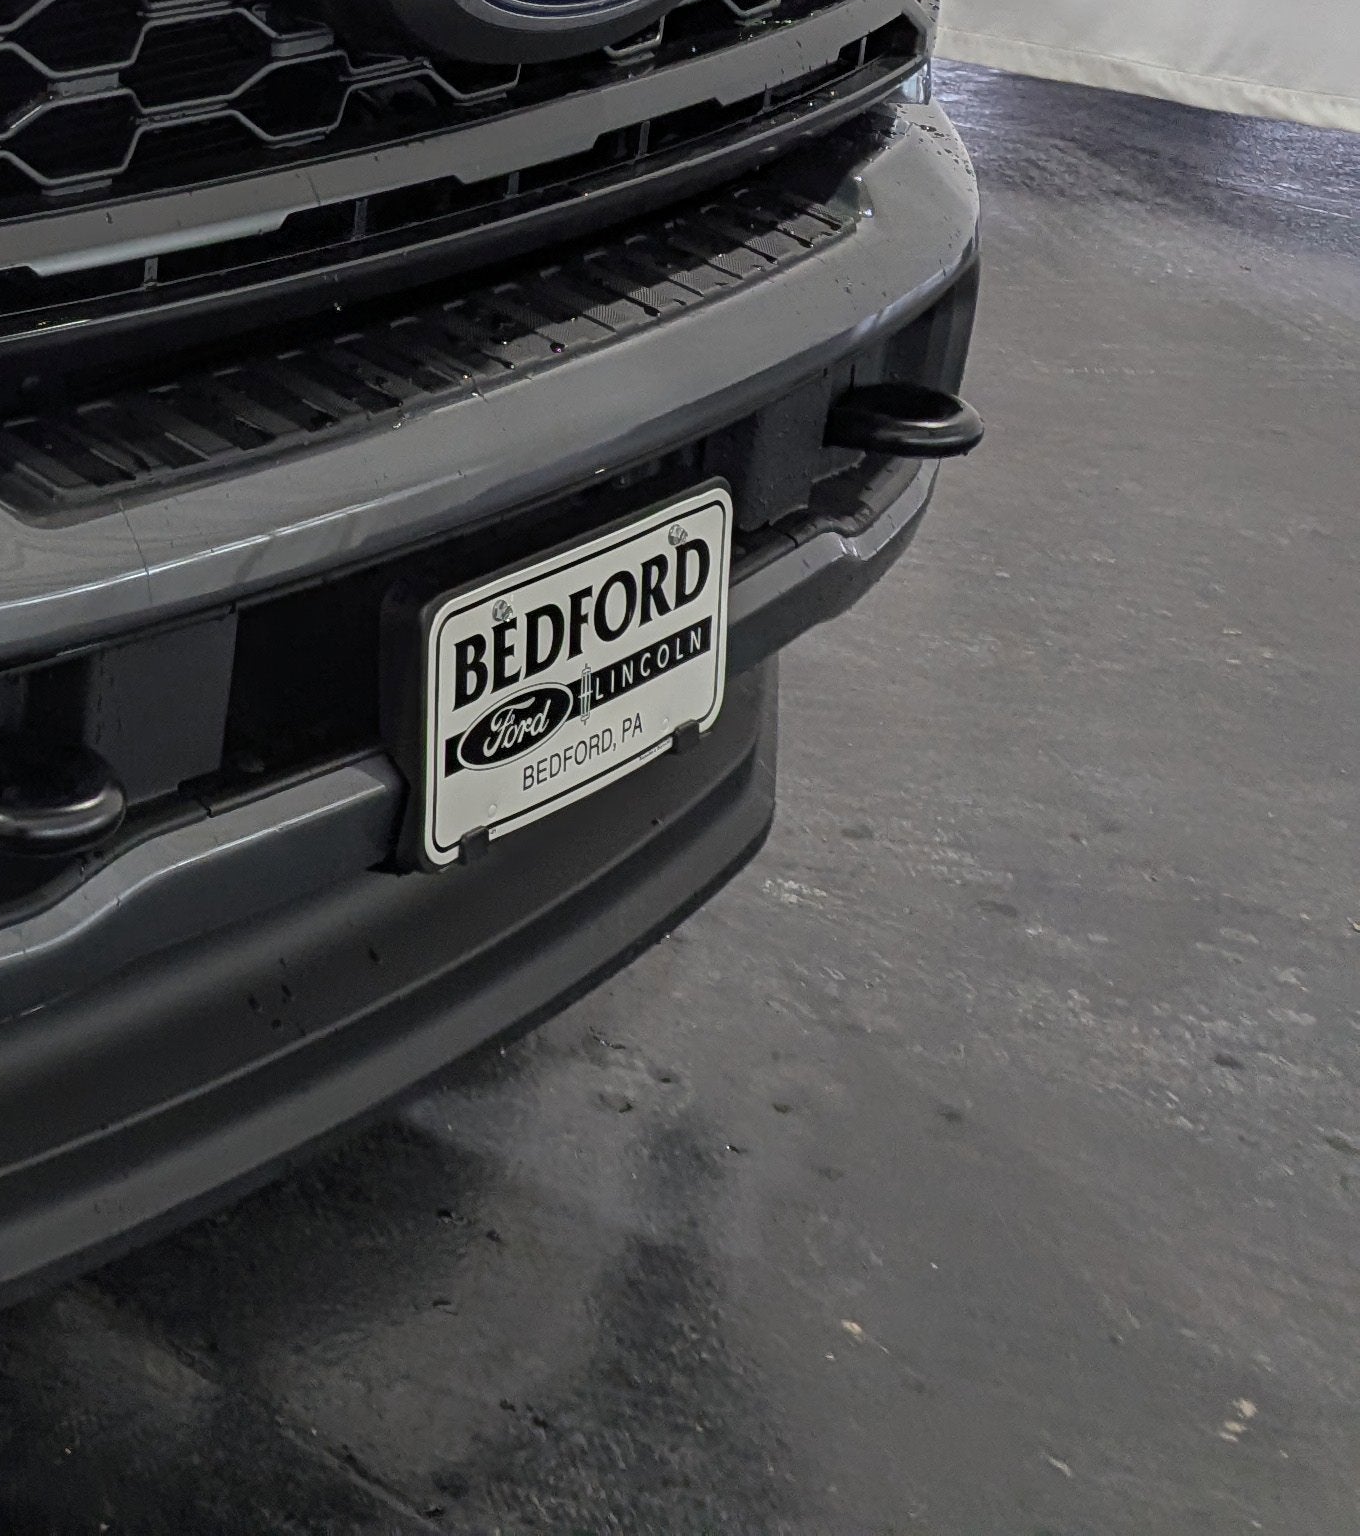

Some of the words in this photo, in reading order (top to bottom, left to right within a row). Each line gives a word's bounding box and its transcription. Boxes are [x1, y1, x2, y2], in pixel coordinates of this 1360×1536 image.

[451, 537, 711, 713] BEDFORD
[483, 697, 552, 757] Ford
[594, 626, 703, 701] LINCOLN
[522, 730, 617, 792] BEDFORD,
[621, 711, 644, 744] PA
